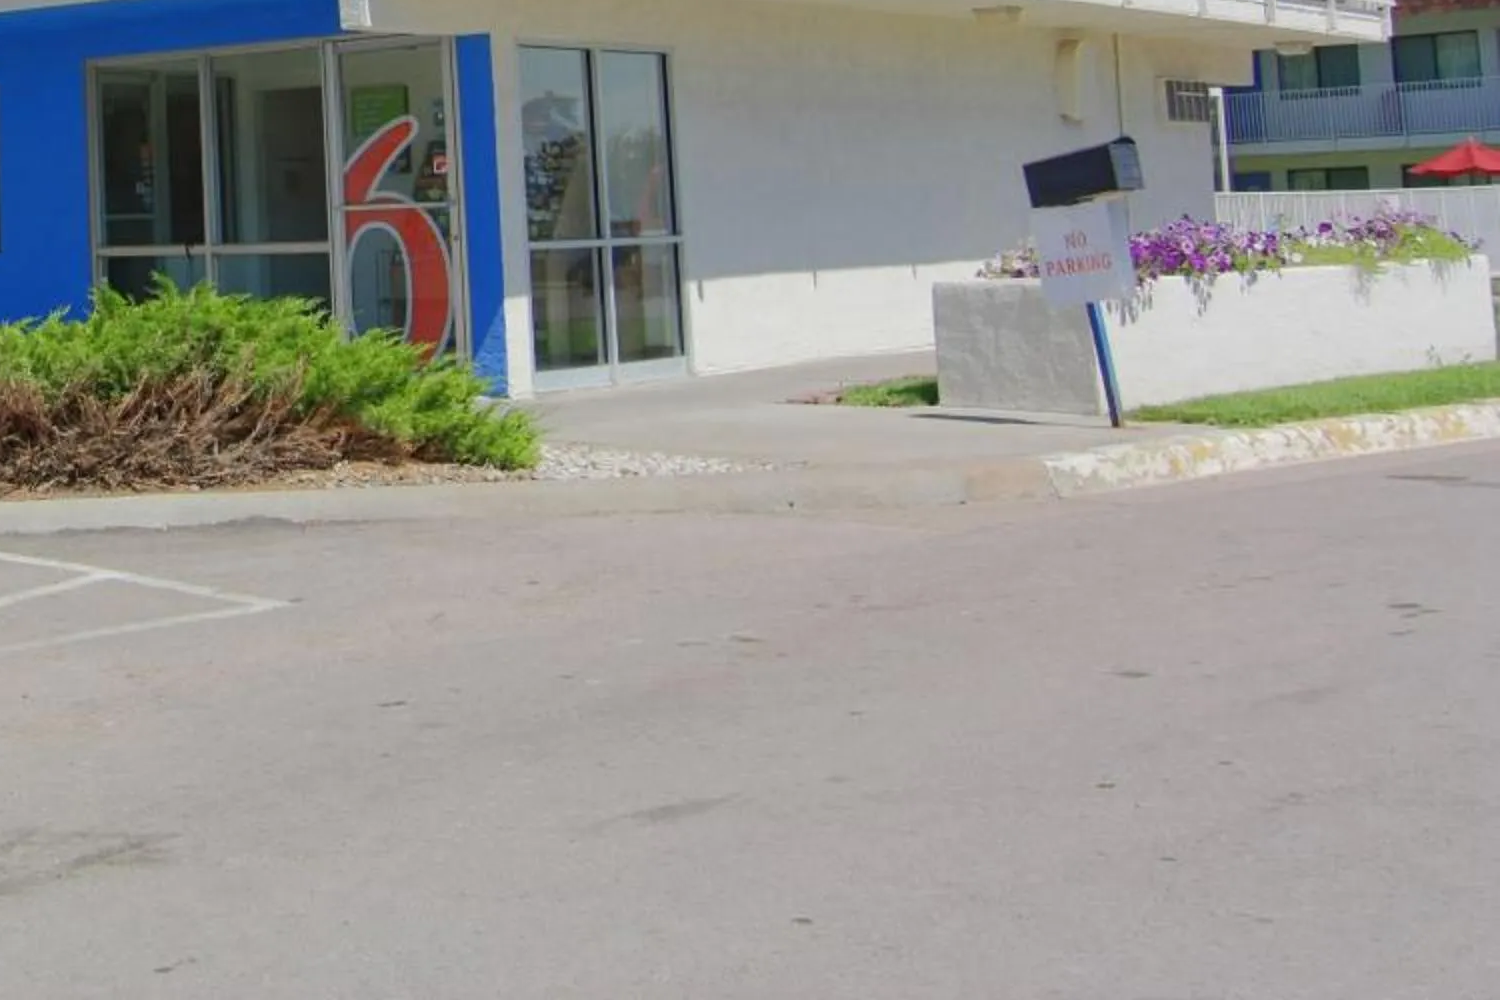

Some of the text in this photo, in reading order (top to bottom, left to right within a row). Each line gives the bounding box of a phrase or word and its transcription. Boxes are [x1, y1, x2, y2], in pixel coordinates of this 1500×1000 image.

[343, 114, 451, 370] 6
[1063, 230, 1087, 249] NO
[1046, 253, 1112, 276] PARKING
